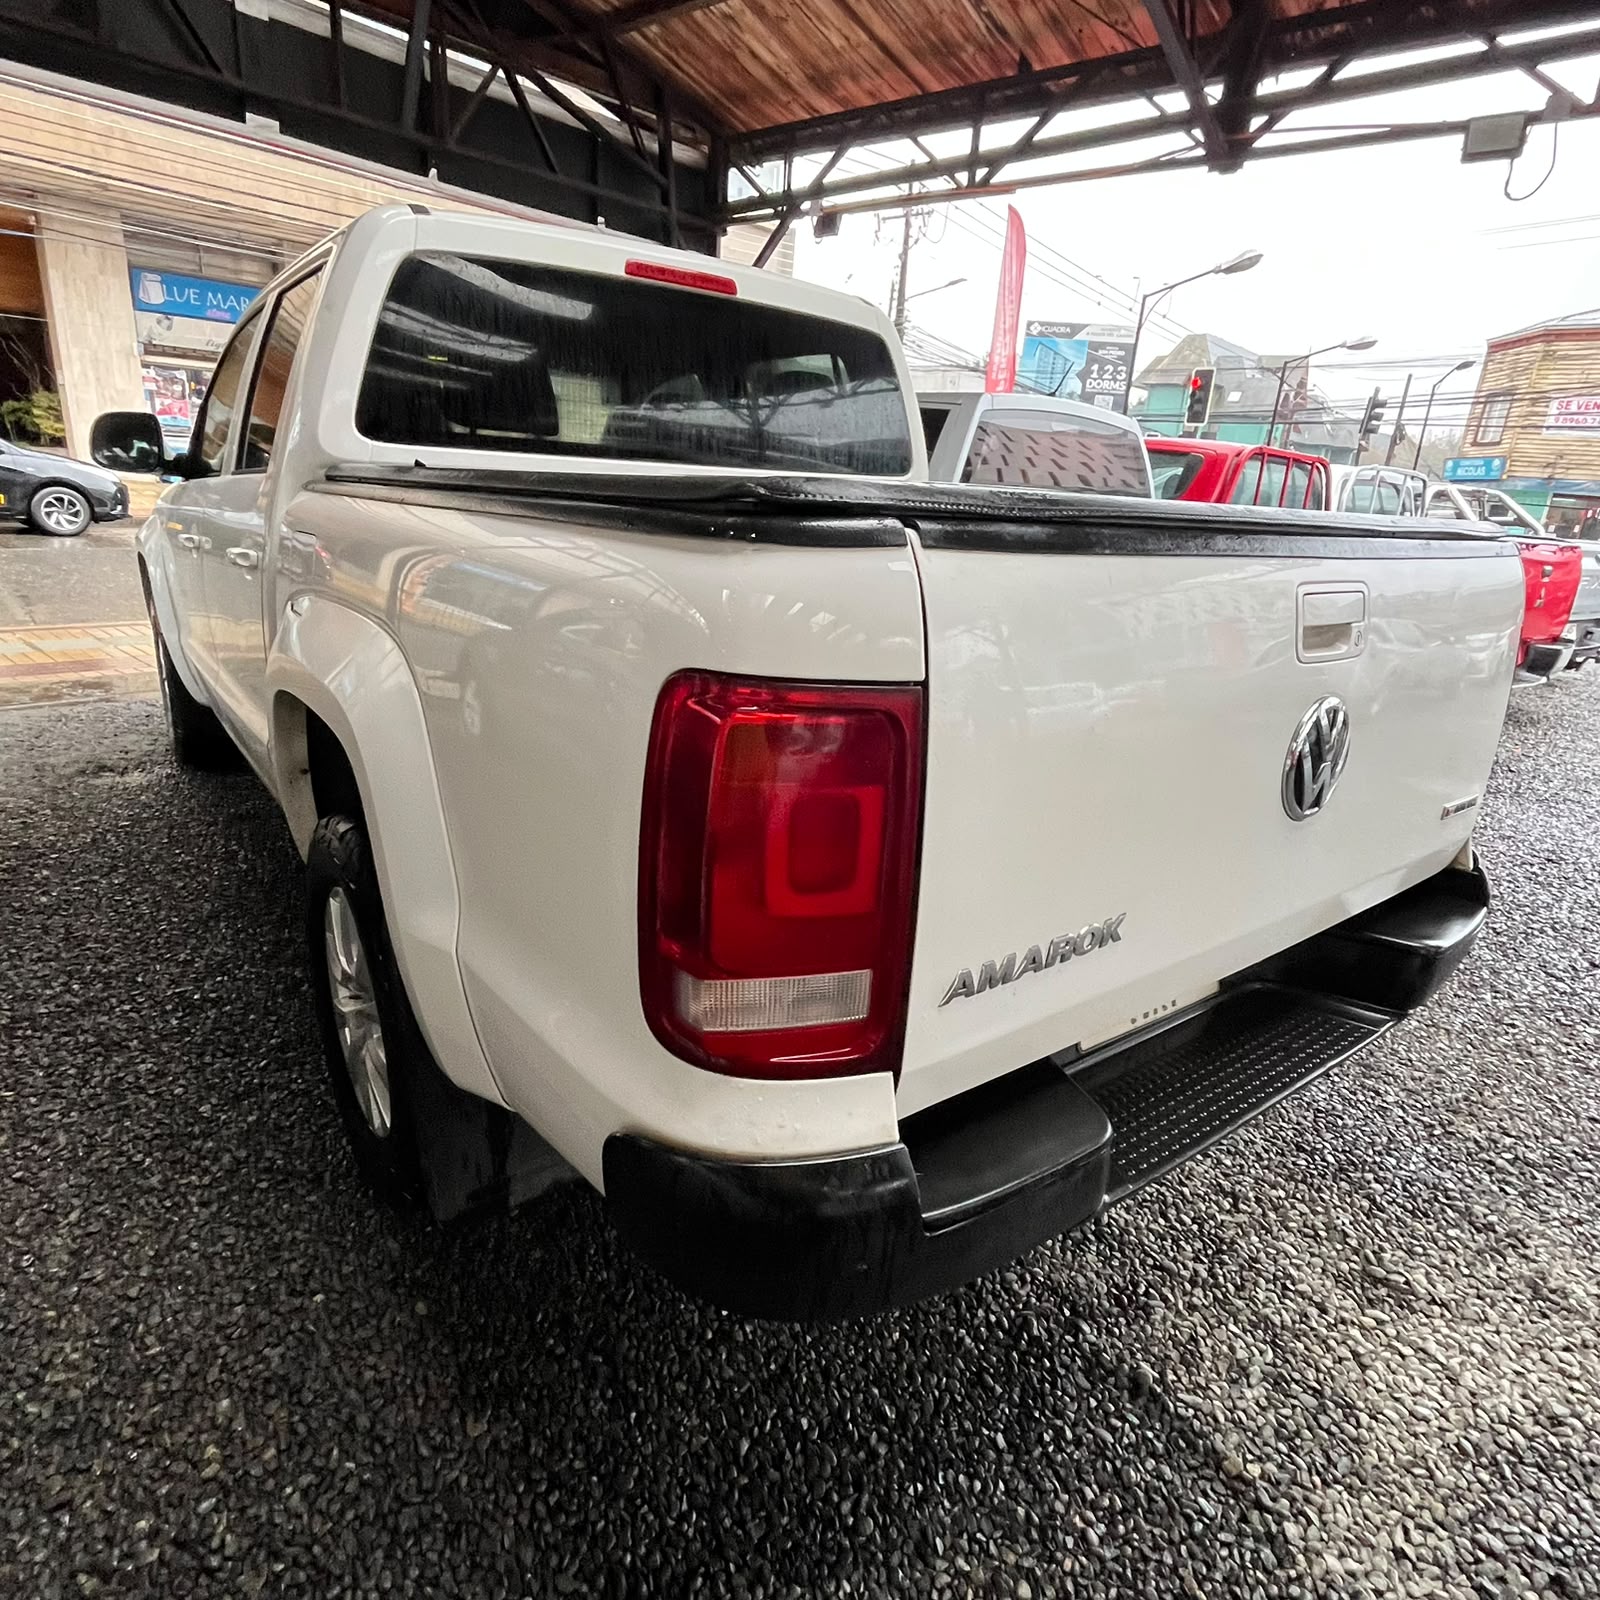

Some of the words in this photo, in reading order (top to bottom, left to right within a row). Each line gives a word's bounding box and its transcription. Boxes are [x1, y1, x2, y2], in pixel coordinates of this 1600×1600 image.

[1085, 379, 1127, 390] DORMS
[1556, 400, 1573, 410] SE
[938, 912, 1127, 1008] AMAROK
